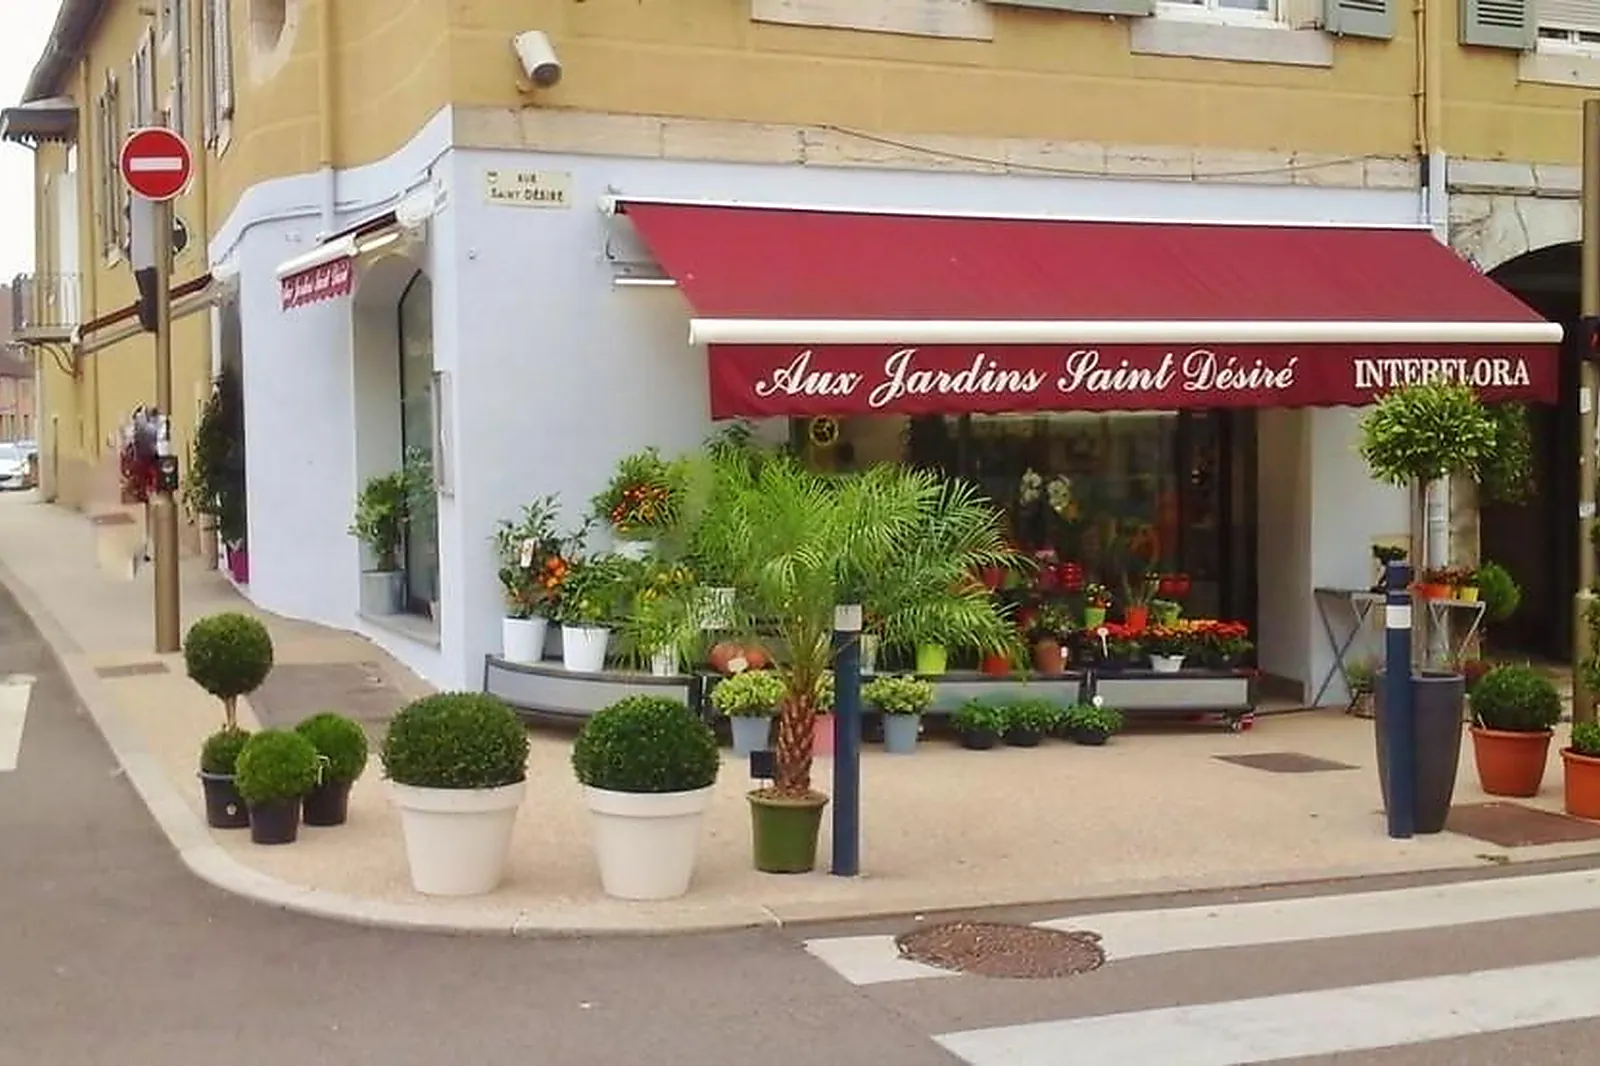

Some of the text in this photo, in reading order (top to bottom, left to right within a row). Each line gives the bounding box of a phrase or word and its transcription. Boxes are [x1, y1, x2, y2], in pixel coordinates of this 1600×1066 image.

[755, 349, 1300, 408] Aux Jardins Saint Désiré
[1354, 357, 1531, 388] INTERFLORA
